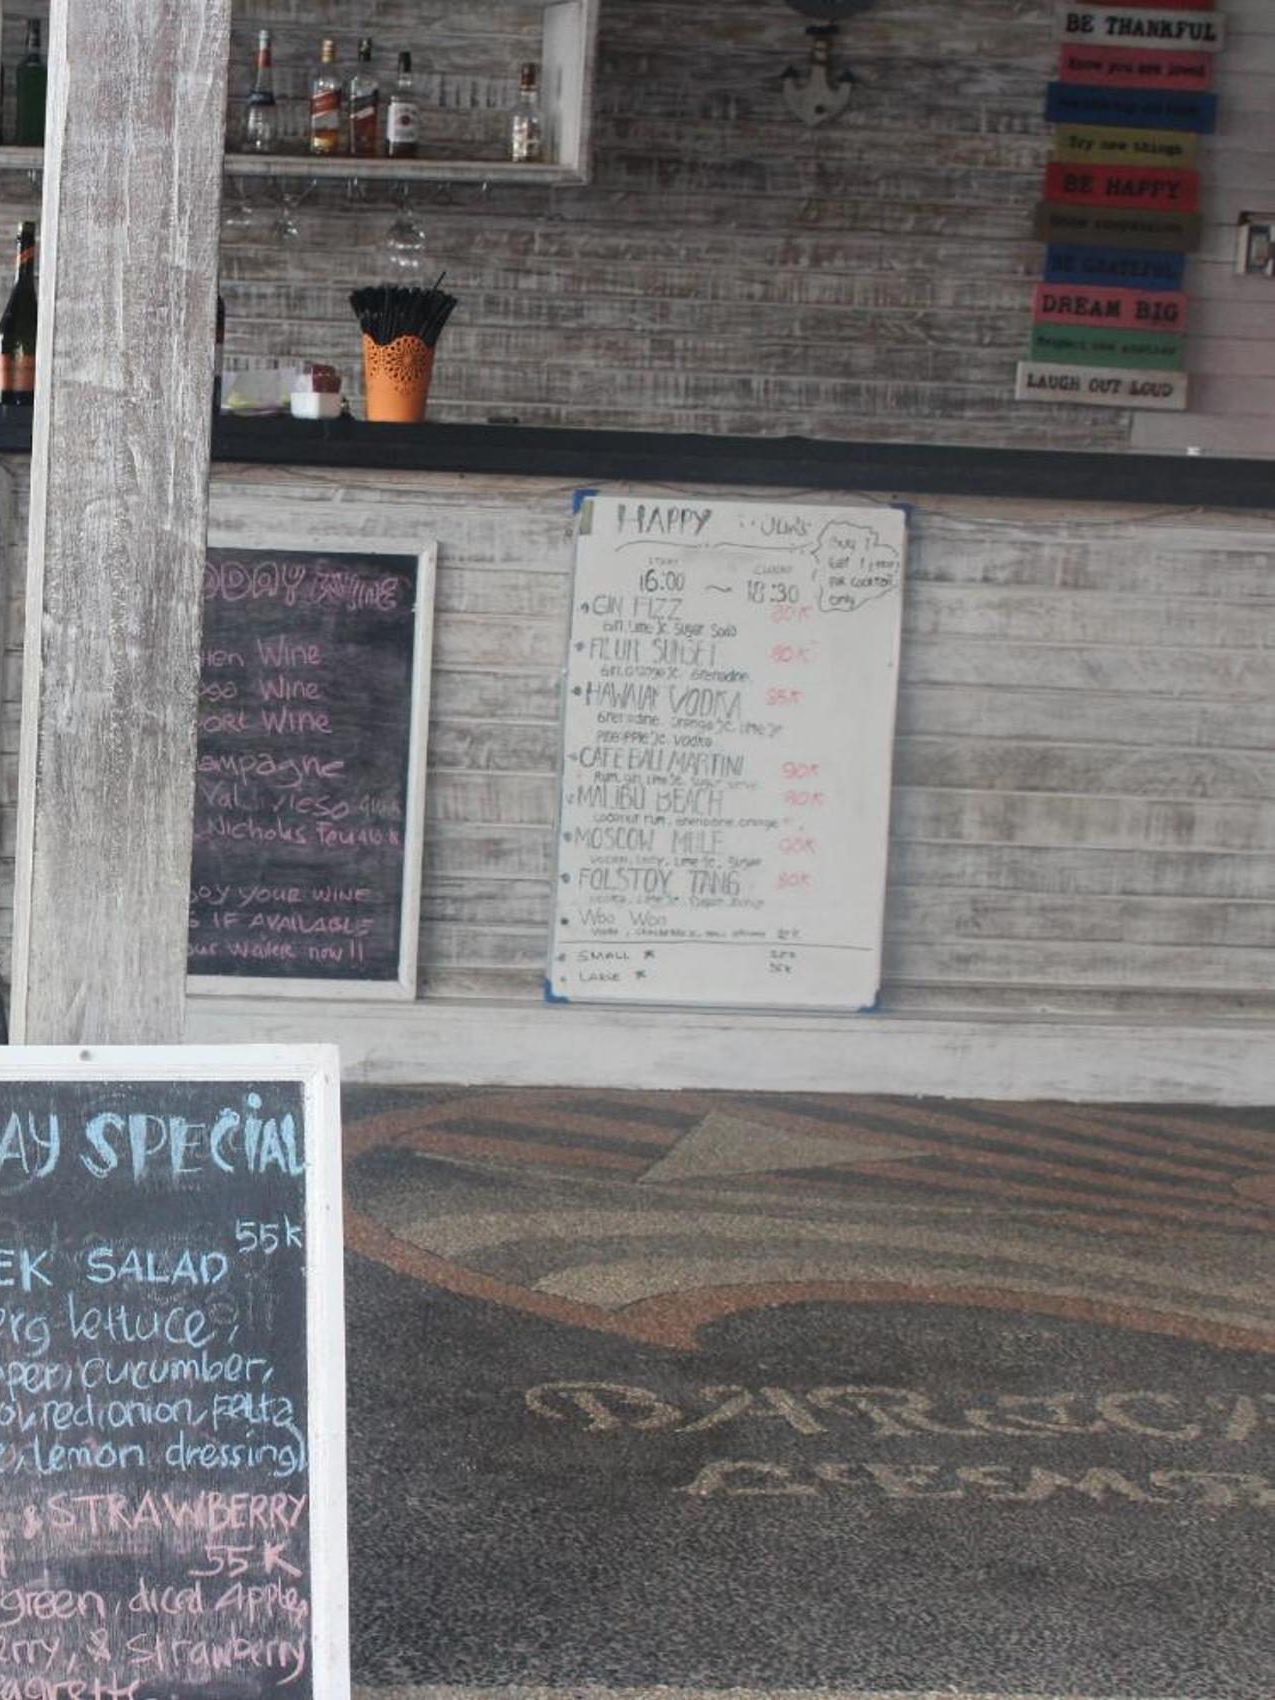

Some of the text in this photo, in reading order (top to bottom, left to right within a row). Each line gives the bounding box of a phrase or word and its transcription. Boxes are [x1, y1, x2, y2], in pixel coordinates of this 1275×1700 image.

[1065, 13, 1217, 42] BE THANKFUL
[1108, 60, 1133, 77] you
[1069, 136, 1093, 152] Try
[1063, 175, 1183, 199] BE HAPPY
[1041, 294, 1179, 322] DREAM BIG
[1026, 373, 1174, 397] LAUGH OUT LOUD
[618, 504, 712, 535] HAPPY
[639, 568, 685, 592] 16:00
[592, 596, 683, 621] GIN FIZZ
[257, 635, 322, 668] Wine
[258, 673, 322, 700] Wine
[669, 684, 742, 720] VODKA
[261, 705, 333, 734] Wine
[197, 753, 345, 787] ampagne
[666, 751, 745, 777] MARTINI
[577, 784, 726, 816] MALIBU BEACH
[575, 827, 724, 855] MOSCOW MULE
[312, 888, 371, 904] WINE
[688, 869, 741, 897] TANG
[213, 911, 241, 928] IF
[249, 912, 375, 936] AVAILABLE
[576, 951, 630, 961] SMALL
[86, 1247, 228, 1286] SALAD
[35, 1433, 145, 1475] lemon
[48, 1489, 307, 1536] STRAWBERRY
